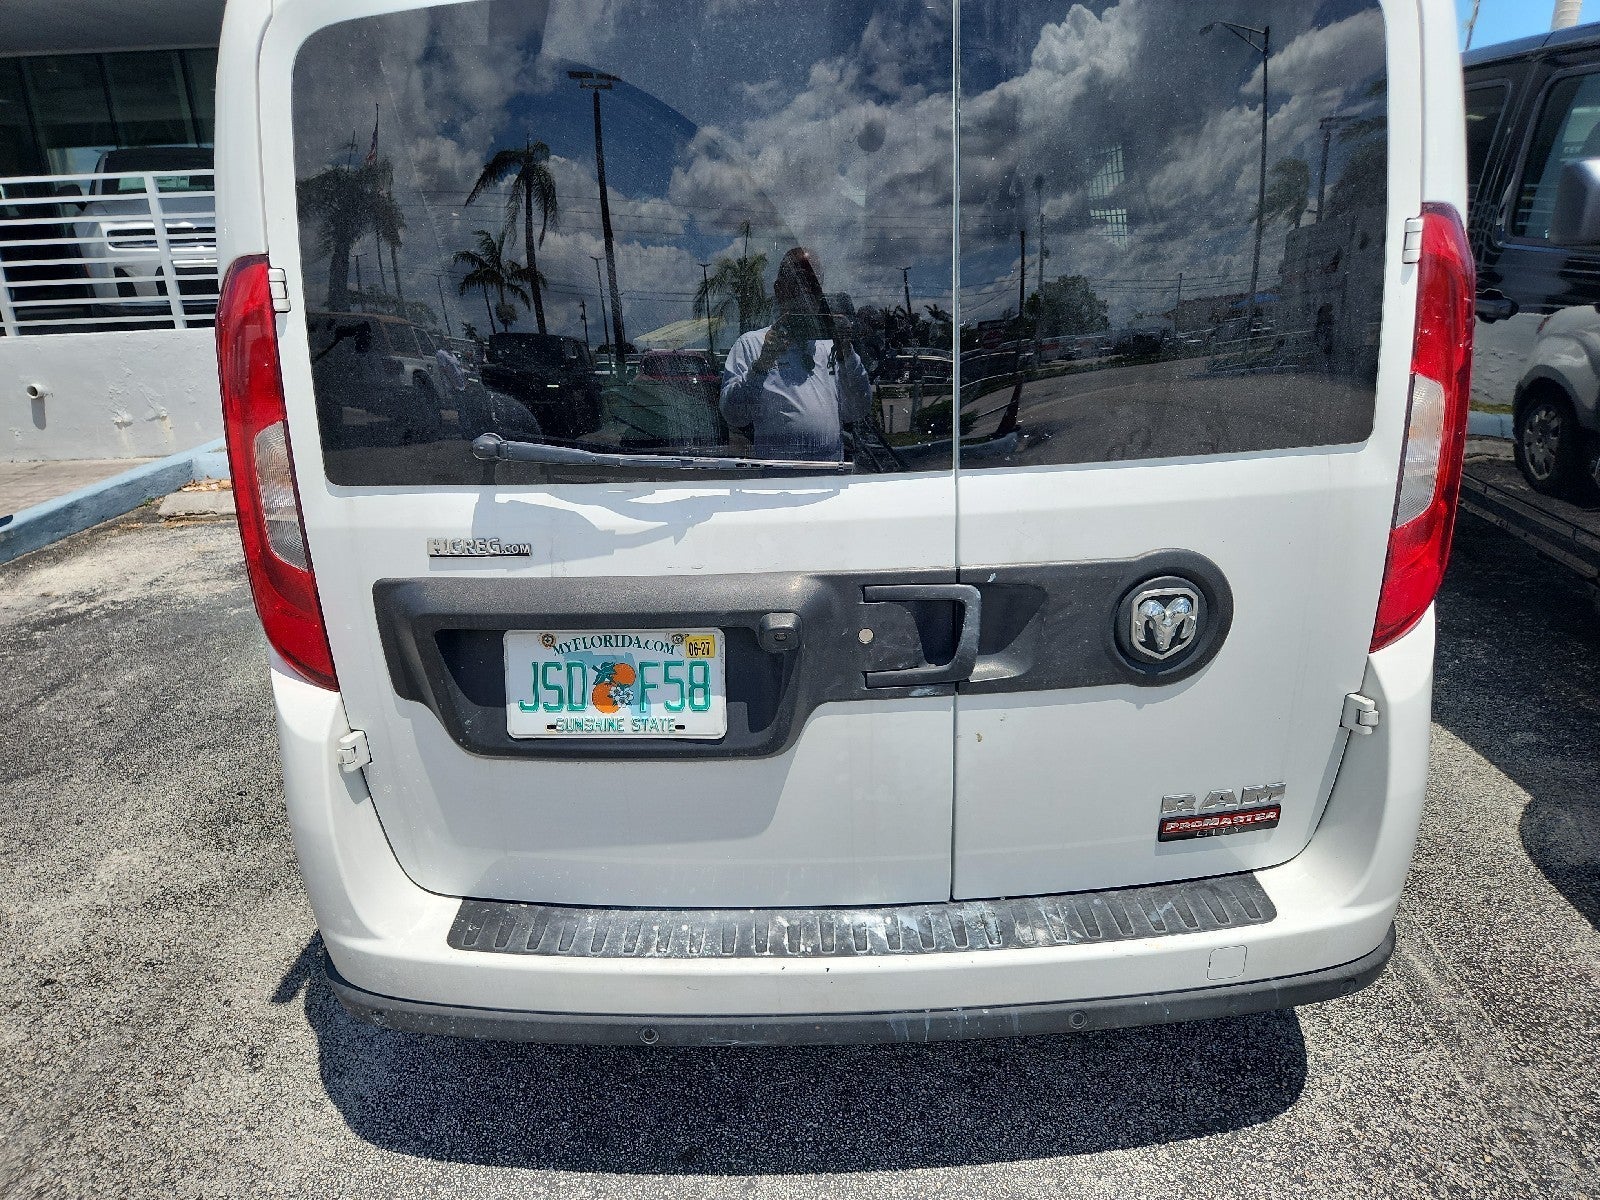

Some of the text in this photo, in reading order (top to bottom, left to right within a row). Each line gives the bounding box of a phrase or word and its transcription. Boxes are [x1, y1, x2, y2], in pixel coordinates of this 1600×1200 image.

[553, 634, 675, 656] MYFLORIDA.COM
[688, 641, 711, 656] 06-27
[518, 660, 711, 713] JSD F58
[555, 717, 676, 733] SUNSHINE STATE
[1161, 782, 1287, 815] RAM
[1165, 811, 1277, 831] PROMASTER
[1196, 826, 1243, 837] CITY
